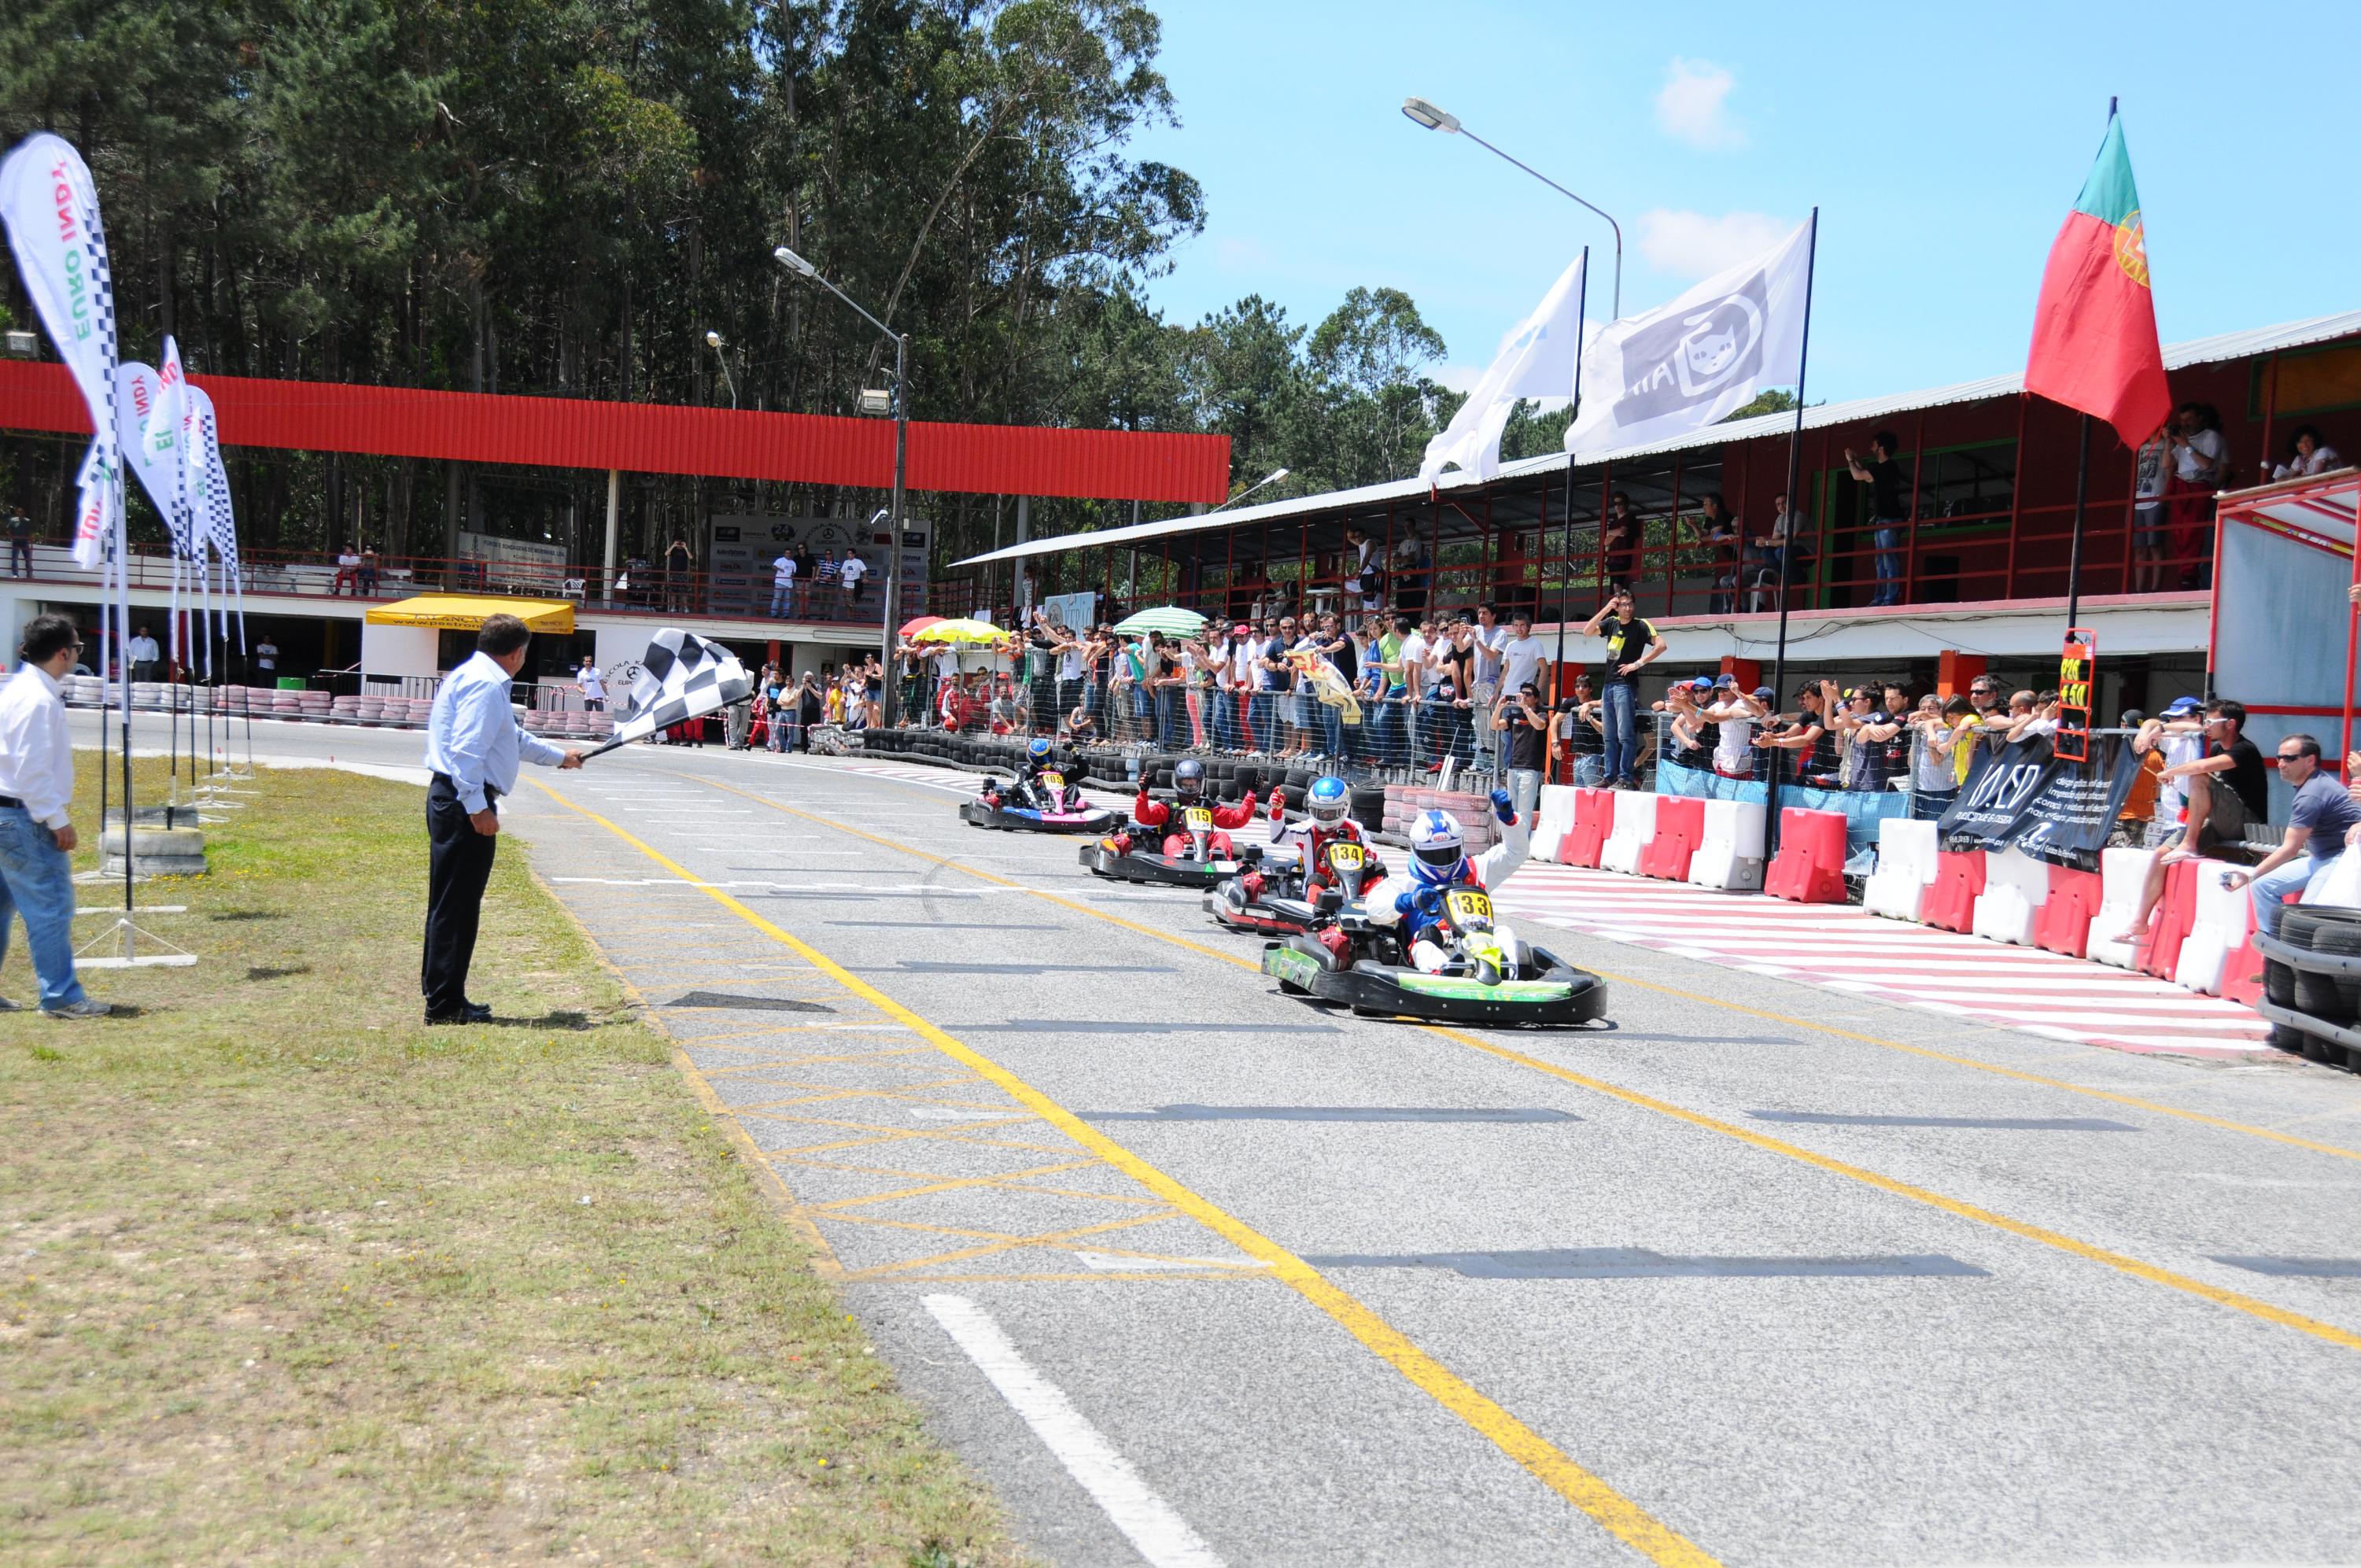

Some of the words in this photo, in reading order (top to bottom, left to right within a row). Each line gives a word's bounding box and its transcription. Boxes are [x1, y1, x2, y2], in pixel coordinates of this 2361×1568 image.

[604, 660, 630, 684] ESCOLA
[2060, 658, 2081, 681] P26
[1045, 775, 1062, 784] 105
[1189, 810, 1209, 822] 115
[1331, 846, 1360, 861] 134
[1449, 895, 1489, 917] 133
